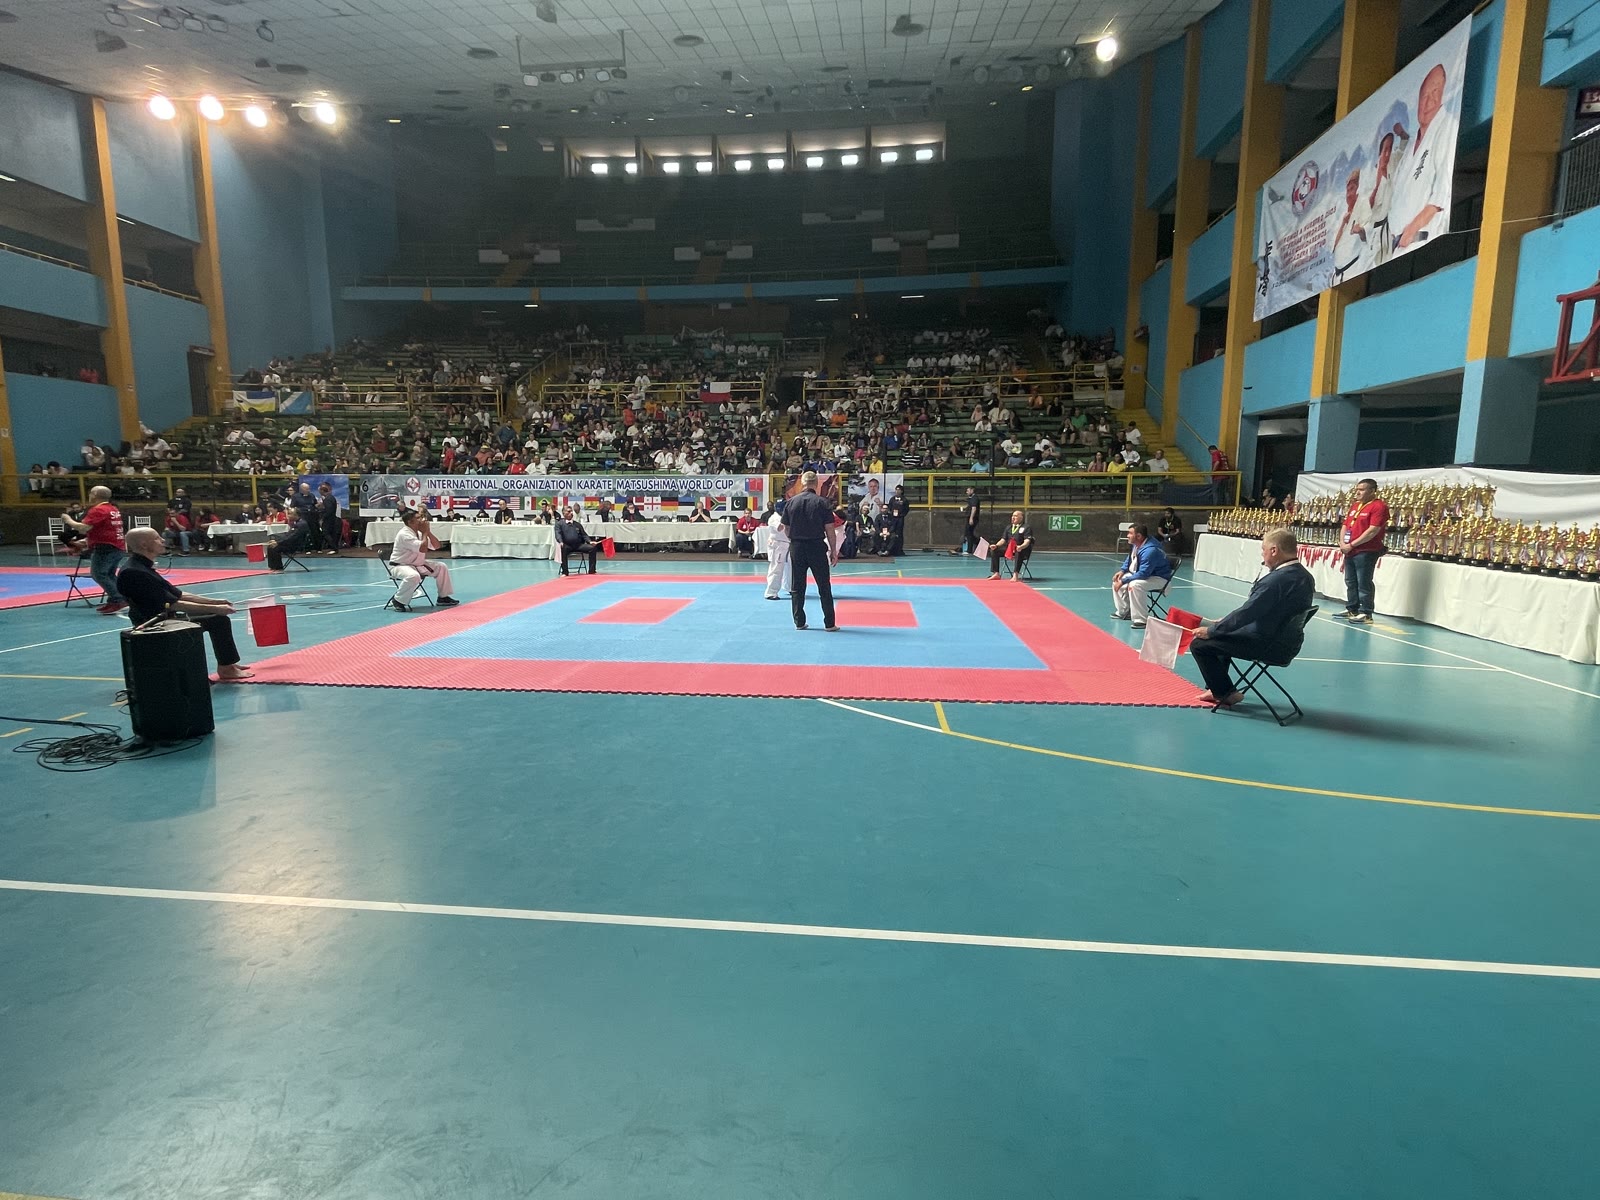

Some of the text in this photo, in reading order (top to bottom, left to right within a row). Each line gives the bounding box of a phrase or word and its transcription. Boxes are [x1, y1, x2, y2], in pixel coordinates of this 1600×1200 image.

[427, 479, 734, 490] INTERNATIONAL ORGANIZATION KARATE MATSUSHIMA WORLD CUP
